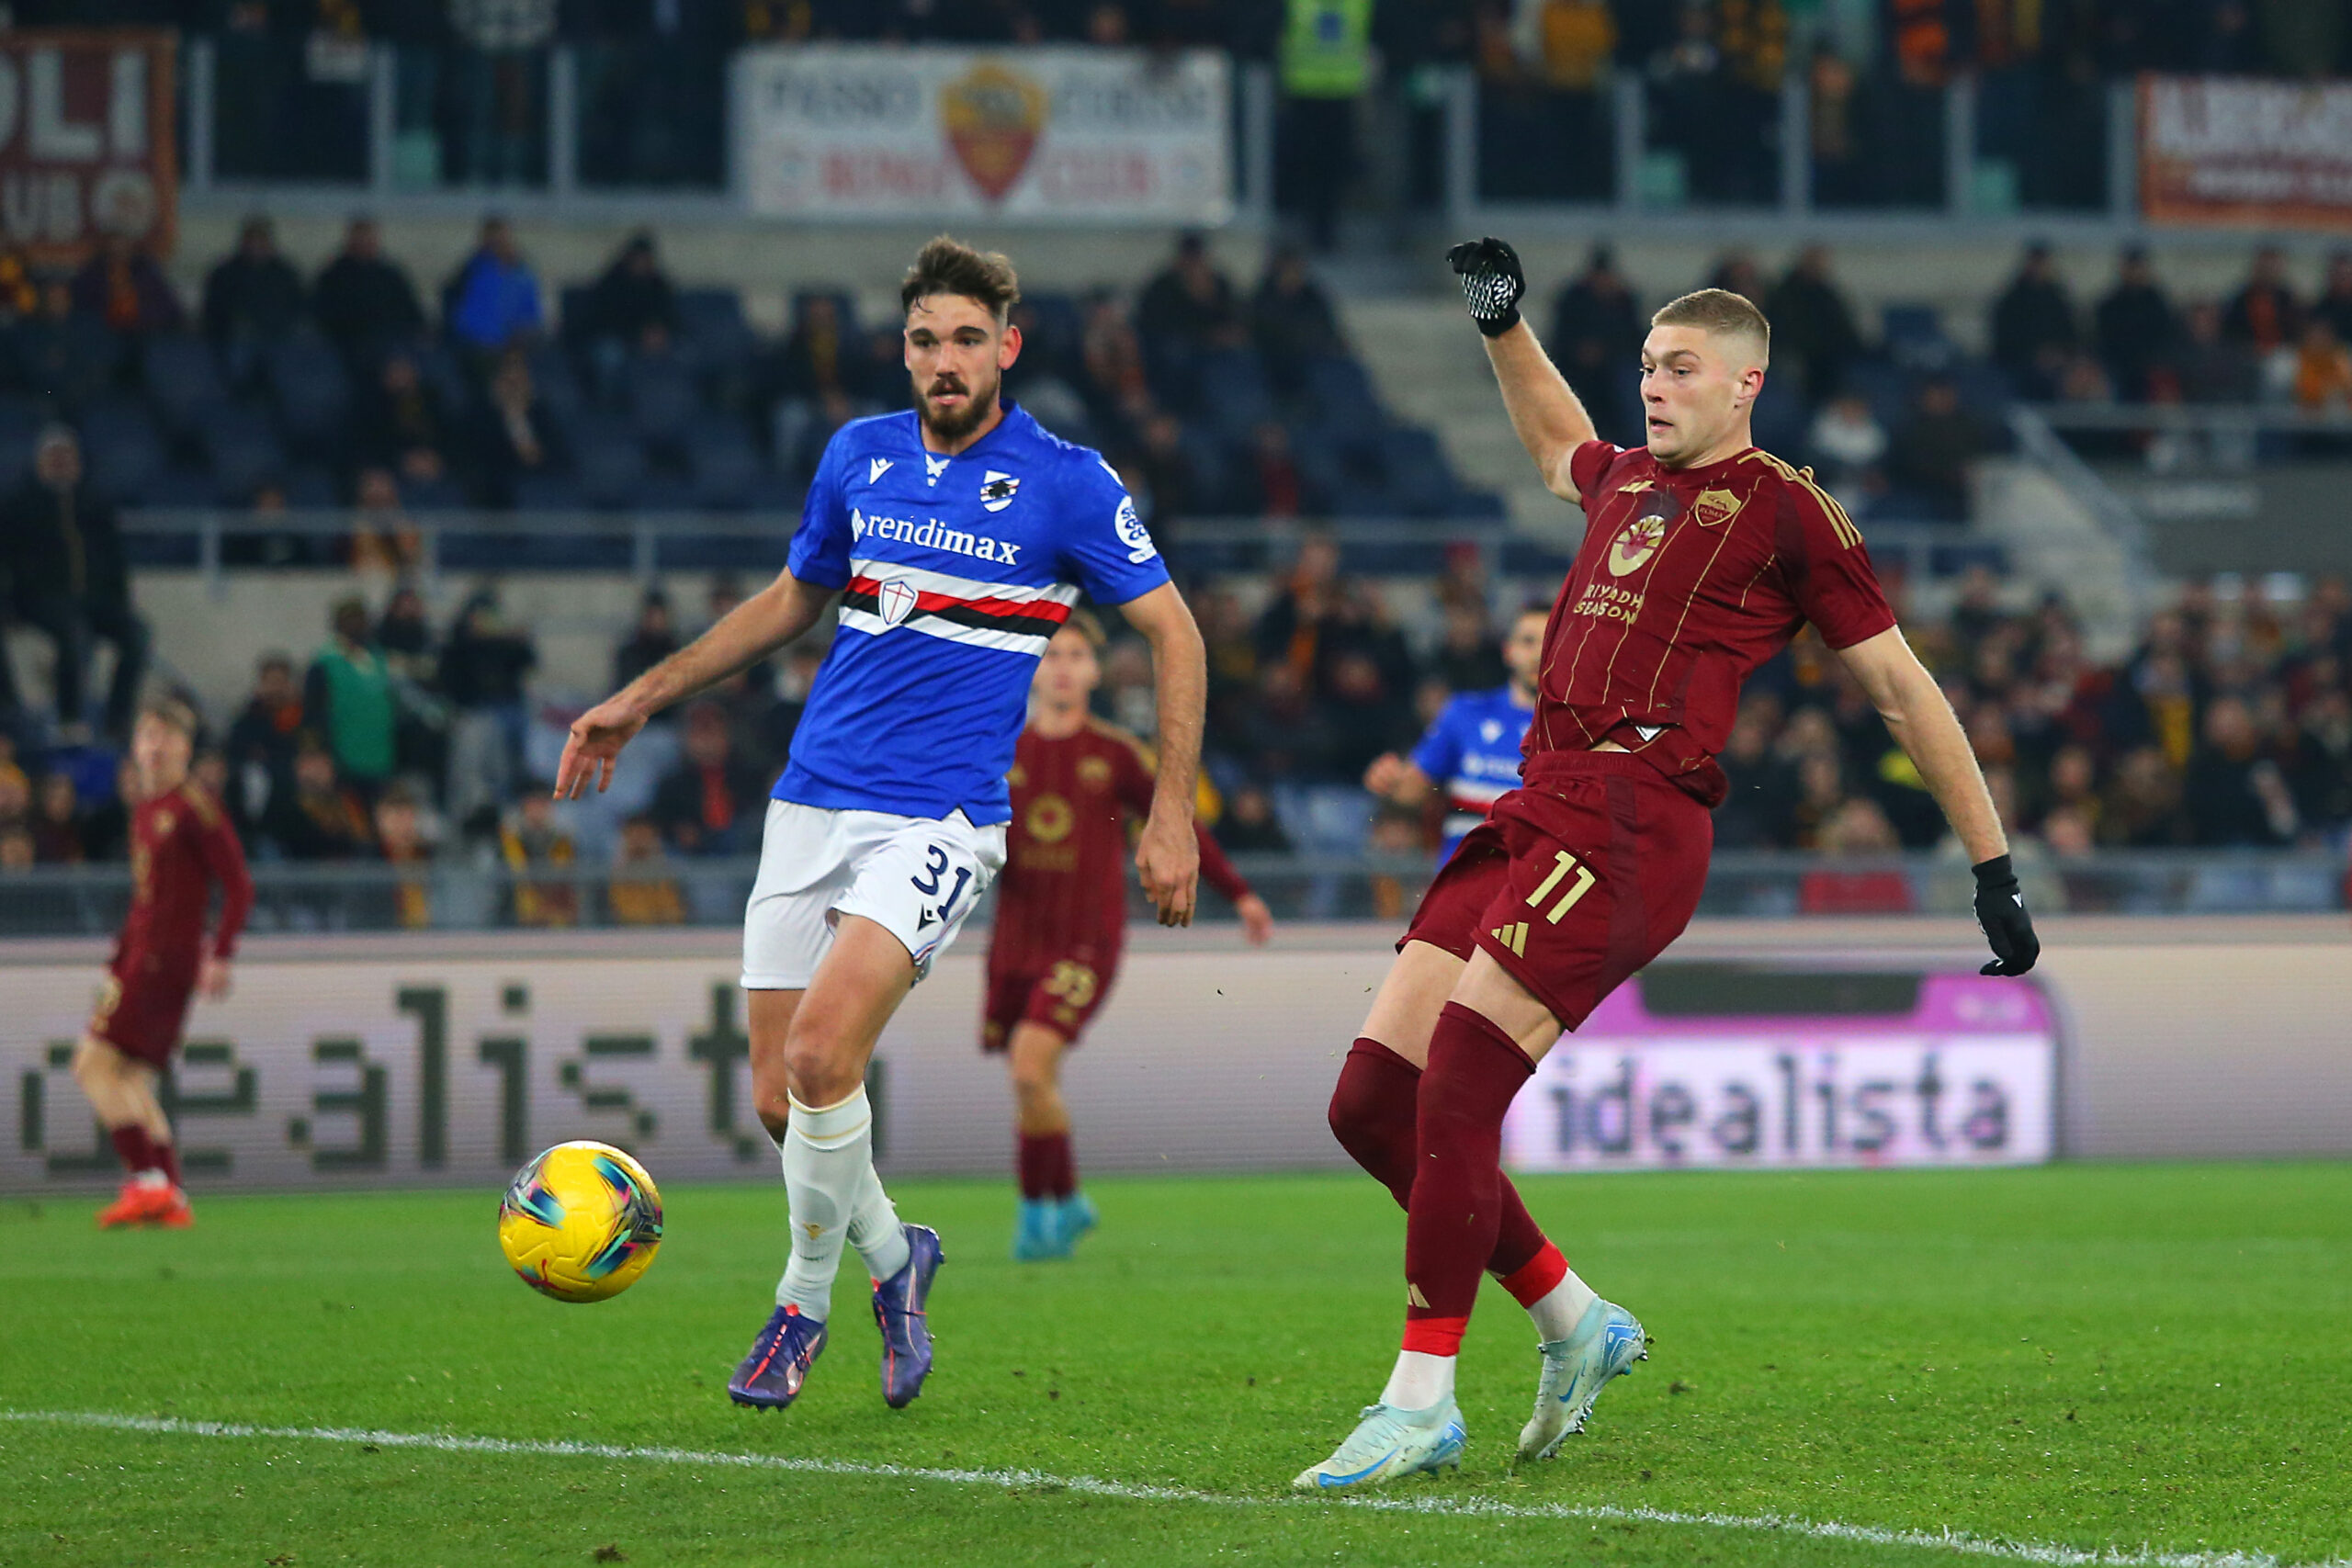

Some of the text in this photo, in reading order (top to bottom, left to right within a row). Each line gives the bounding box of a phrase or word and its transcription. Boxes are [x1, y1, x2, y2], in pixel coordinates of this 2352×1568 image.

[0, 46, 150, 162] LI
[866, 517, 1022, 566] rendimax
[1572, 601, 1640, 626] SEASON
[1584, 583, 1645, 609] RIYADH
[910, 844, 973, 921] 31
[1525, 850, 1597, 925] 11
[20, 983, 888, 1174] ealist
[1547, 1054, 2014, 1154] idealista
